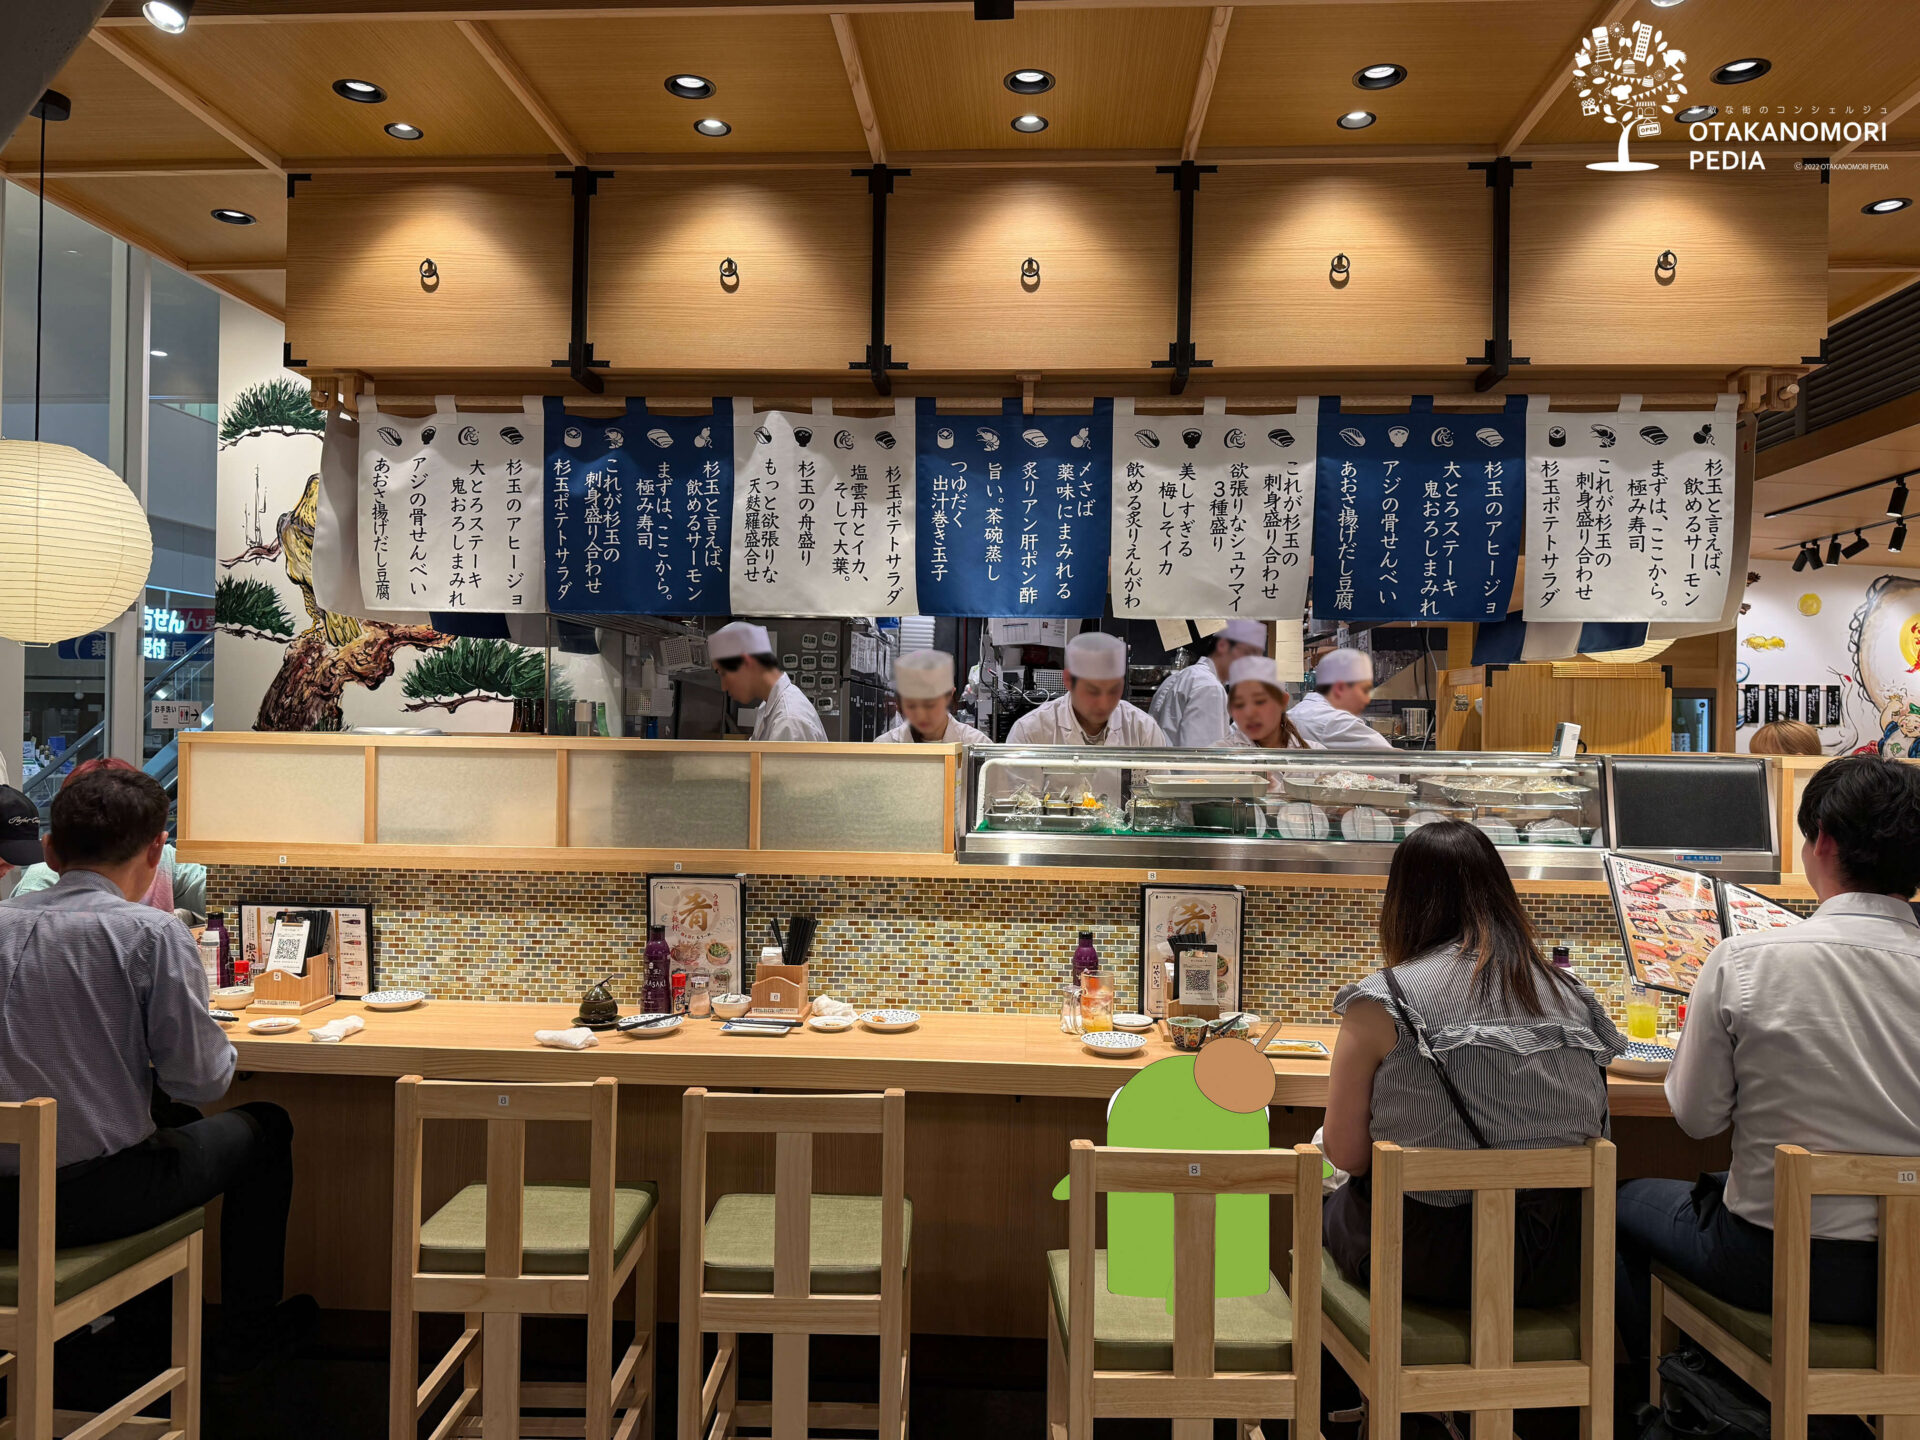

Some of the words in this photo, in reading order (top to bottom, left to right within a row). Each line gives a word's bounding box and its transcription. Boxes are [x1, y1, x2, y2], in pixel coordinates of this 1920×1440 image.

[372, 458, 390, 600] あおさ揚げだし豆腐
[409, 457, 428, 596] アジの骨せんべい
[448, 477, 466, 607] 鬼おろしまみれ
[469, 459, 485, 589] 大とろステーキ
[506, 459, 524, 606] 杉玉のアヒージョ
[553, 459, 574, 601] 杉玉ポテトサラダ
[584, 471, 603, 594] 刺身盛り合わせ
[603, 459, 621, 562] これが杉玉の
[635, 479, 655, 550] 極み寿司
[655, 463, 673, 601] まずは、ここから。
[685, 480, 703, 601] 飲めるサーモン
[702, 461, 722, 574] 杉玉と言えば、
[744, 478, 760, 582] 天麩羅盛合せ
[761, 459, 779, 583] もっと欲張りな
[797, 461, 815, 567] 杉玉の舟盛り
[832, 482, 850, 582] そして大葉。
[850, 464, 869, 582] 塩雲丹とイカ、
[885, 466, 903, 606] 杉玉ポテトサラダ
[930, 475, 949, 582] 出汁巻き玉子
[951, 461, 967, 528] つゆだく
[984, 463, 1003, 581] 旨い。茶碗蒸し
[1019, 461, 1039, 604] 炙りアン肝ポン酢
[1056, 464, 1075, 599] 薬味にまみれる
[1124, 462, 1145, 608] 飲める炙りえんがわ
[1158, 481, 1178, 577] 梅しそイカ
[1178, 462, 1196, 557] 美しすぎる
[1227, 463, 1249, 612] 欲張りなシュウマイ
[1262, 474, 1281, 600] 刺身盛り合わせ
[1282, 461, 1302, 566] これが杉玉の
[1334, 461, 1358, 610] あおさ揚げだし豆腐
[1378, 460, 1401, 604] アジの骨せんべい
[1420, 480, 1440, 615] 鬼おろしまみれ
[1442, 461, 1461, 597] 大とろステーキ
[1482, 461, 1503, 614] 杉玉のアヒージョ
[1539, 460, 1560, 608] 杉玉ポテトサラダ
[1575, 472, 1594, 600] 刺身盛り合わせ
[1594, 459, 1614, 567] これが杉玉の
[1627, 479, 1647, 553] 極み寿司
[1649, 460, 1668, 606] まずは、ここから。
[1683, 477, 1704, 607] 飲めるサーモン
[1704, 459, 1723, 576] 杉玉と言えば、
[154, 705, 177, 713] お手洗い
[1191, 1165, 1198, 1174] 8
[1902, 1173, 1914, 1182] 10
